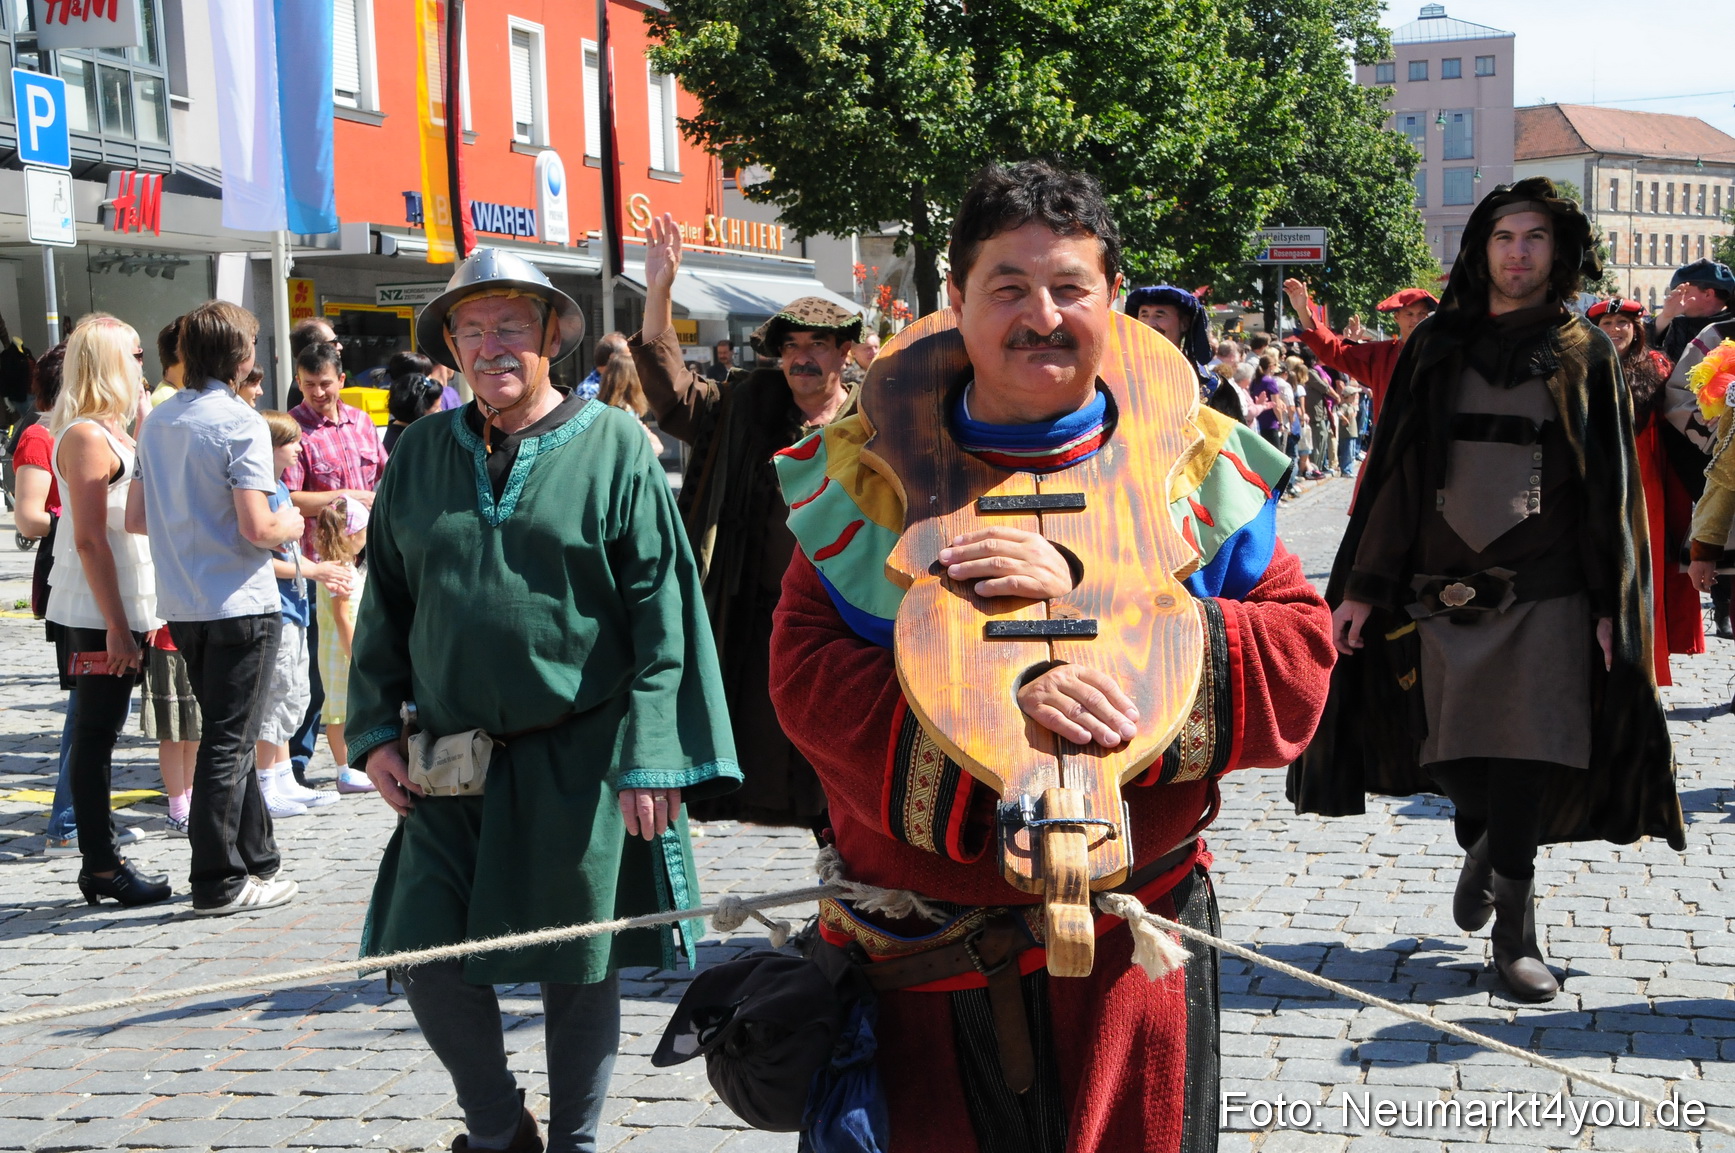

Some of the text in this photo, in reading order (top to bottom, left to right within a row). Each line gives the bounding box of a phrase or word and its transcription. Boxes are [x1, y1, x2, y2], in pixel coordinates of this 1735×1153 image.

[26, 84, 56, 151] P
[111, 170, 163, 237] H&M
[704, 214, 786, 251] SCHLIERF
[1273, 249, 1311, 258] Rosengasse
[379, 289, 403, 301] NZ
[292, 307, 314, 318] LOTTO
